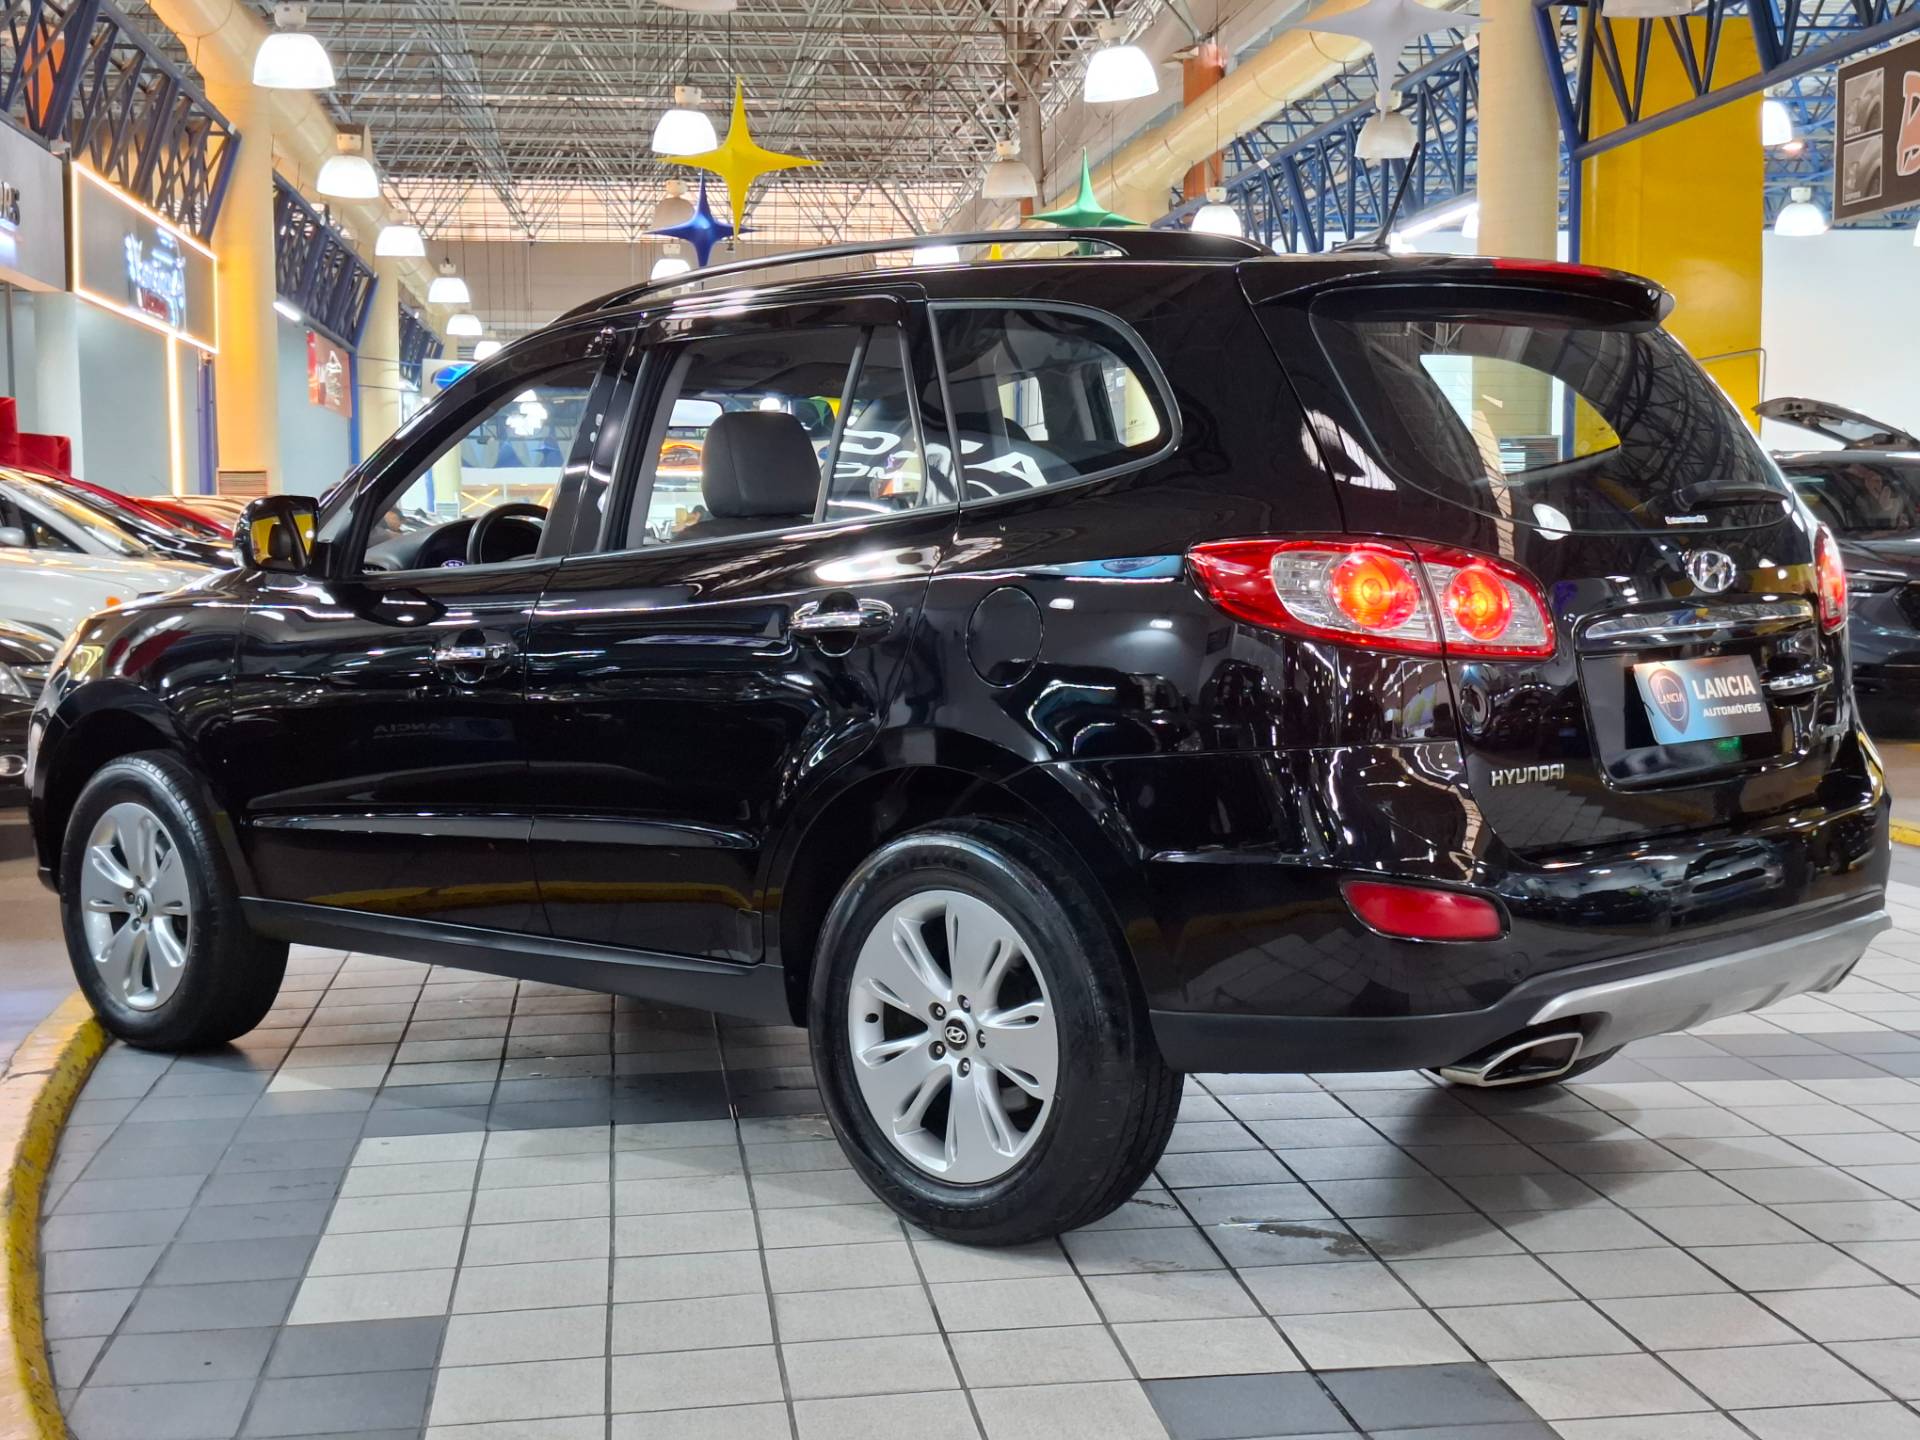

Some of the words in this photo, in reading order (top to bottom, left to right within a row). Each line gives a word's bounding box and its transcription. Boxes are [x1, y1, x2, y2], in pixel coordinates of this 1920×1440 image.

[1692, 674, 1757, 700] LANCIA
[1703, 702, 1762, 717] AUTOMÓVEIS
[1490, 763, 1565, 787] HYUNDAI
